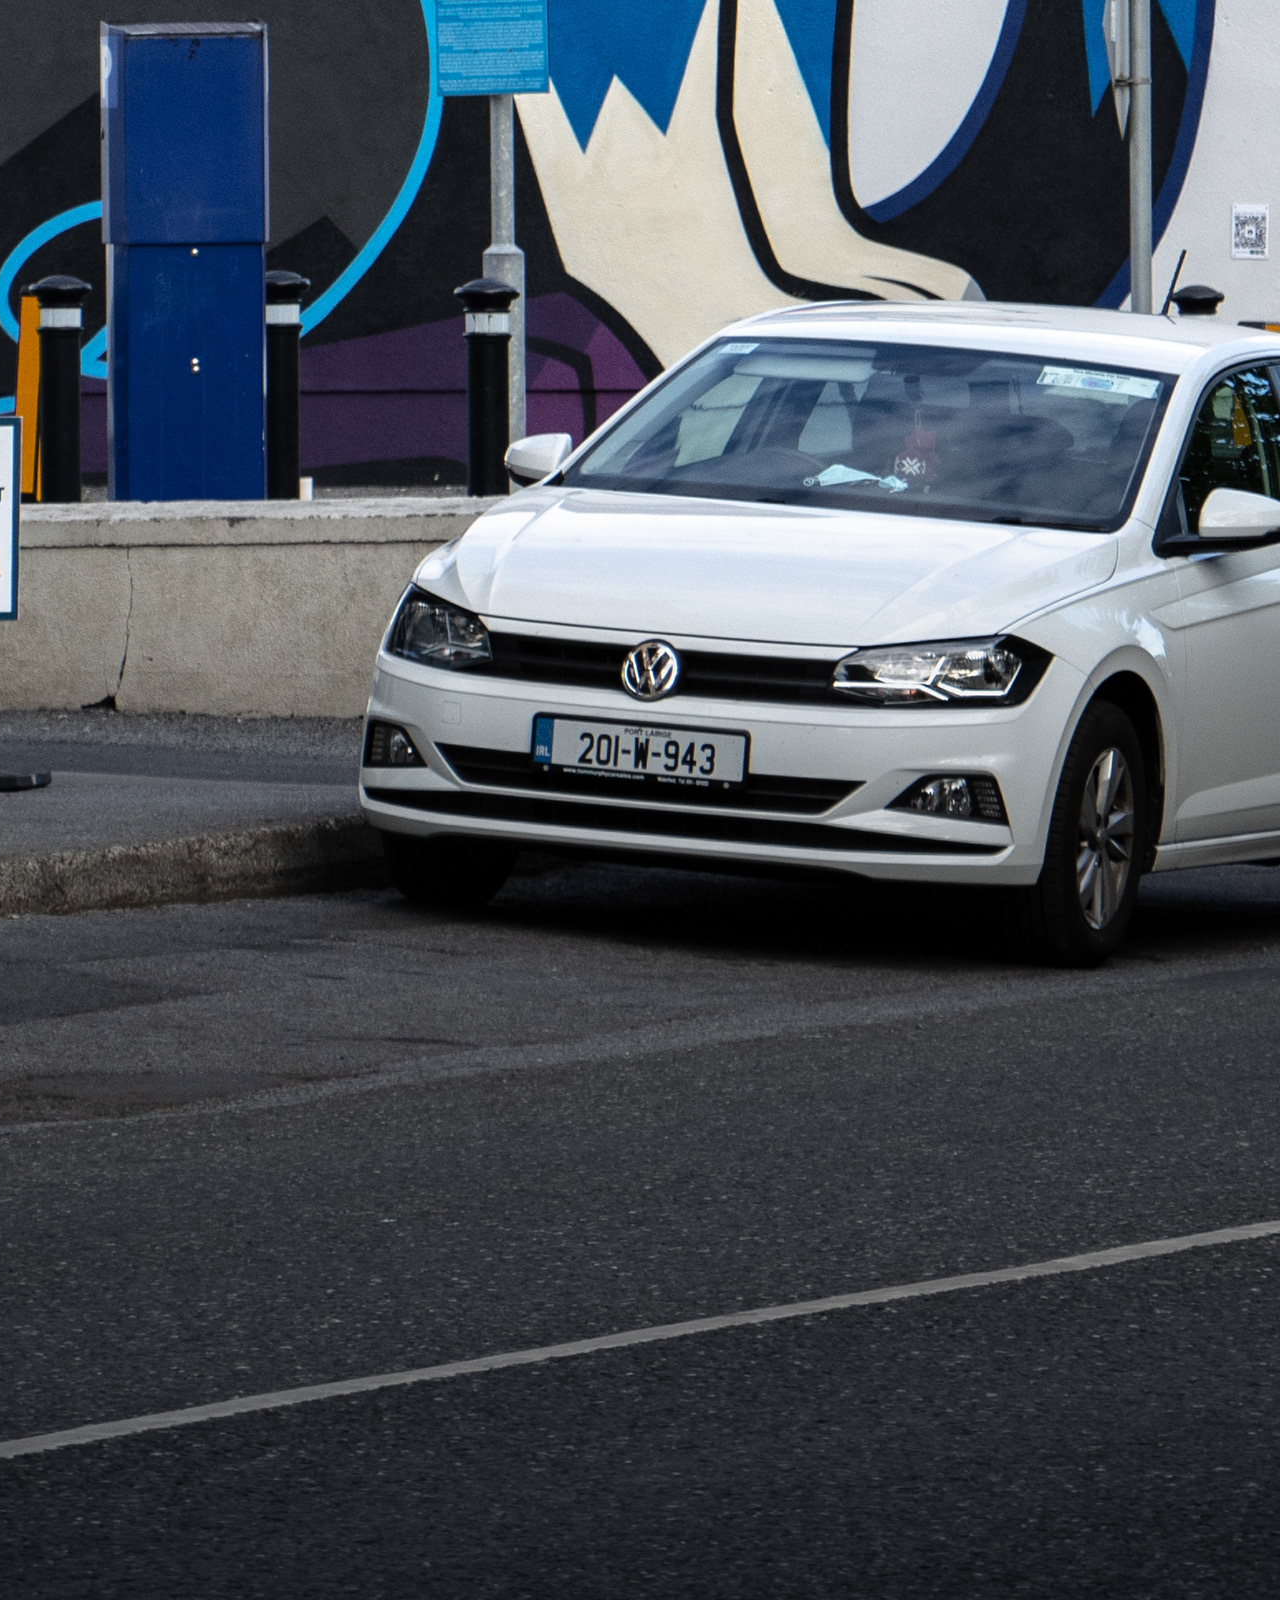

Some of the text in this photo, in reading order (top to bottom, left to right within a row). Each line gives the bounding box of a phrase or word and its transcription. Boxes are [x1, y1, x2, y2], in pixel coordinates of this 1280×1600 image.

[624, 728, 643, 737] PORT
[536, 745, 550, 757] IRL
[578, 732, 716, 776] 201-W-943
